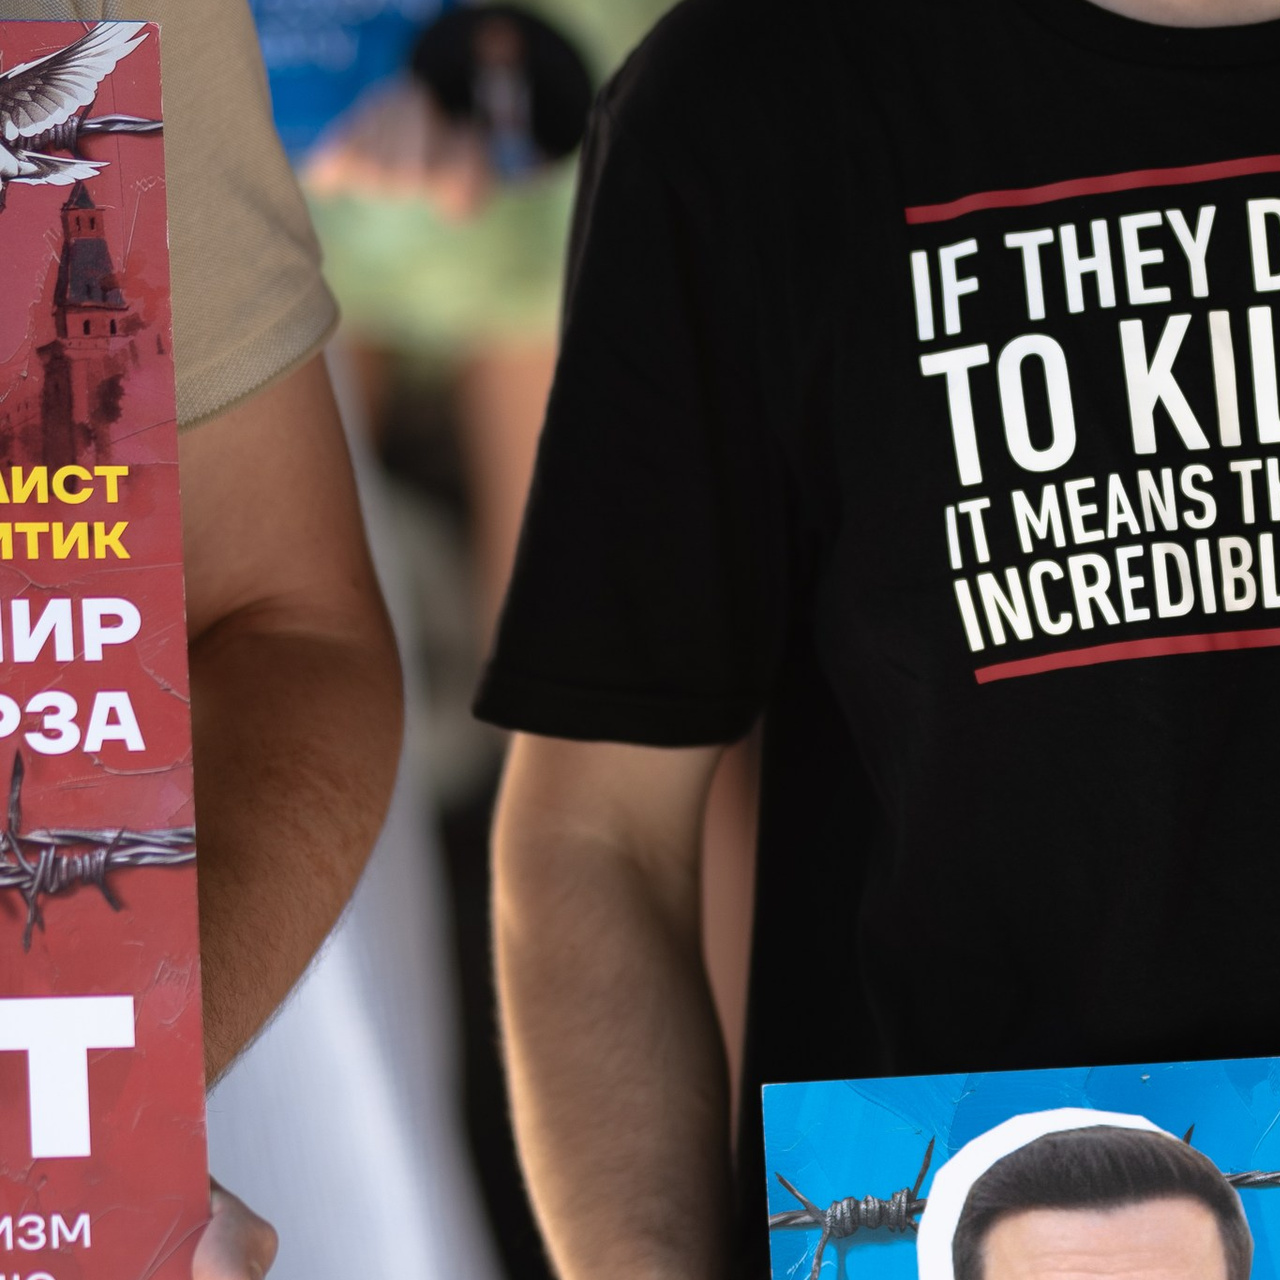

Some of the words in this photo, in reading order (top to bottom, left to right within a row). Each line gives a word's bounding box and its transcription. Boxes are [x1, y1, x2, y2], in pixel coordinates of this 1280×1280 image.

[911, 238, 979, 341] IF
[1005, 204, 1216, 321] THEY
[919, 332, 1077, 487] TO
[0, 464, 130, 504] ИСТ
[945, 496, 992, 570] IT
[1012, 462, 1217, 554] MEANS
[0, 596, 142, 663] ИР
